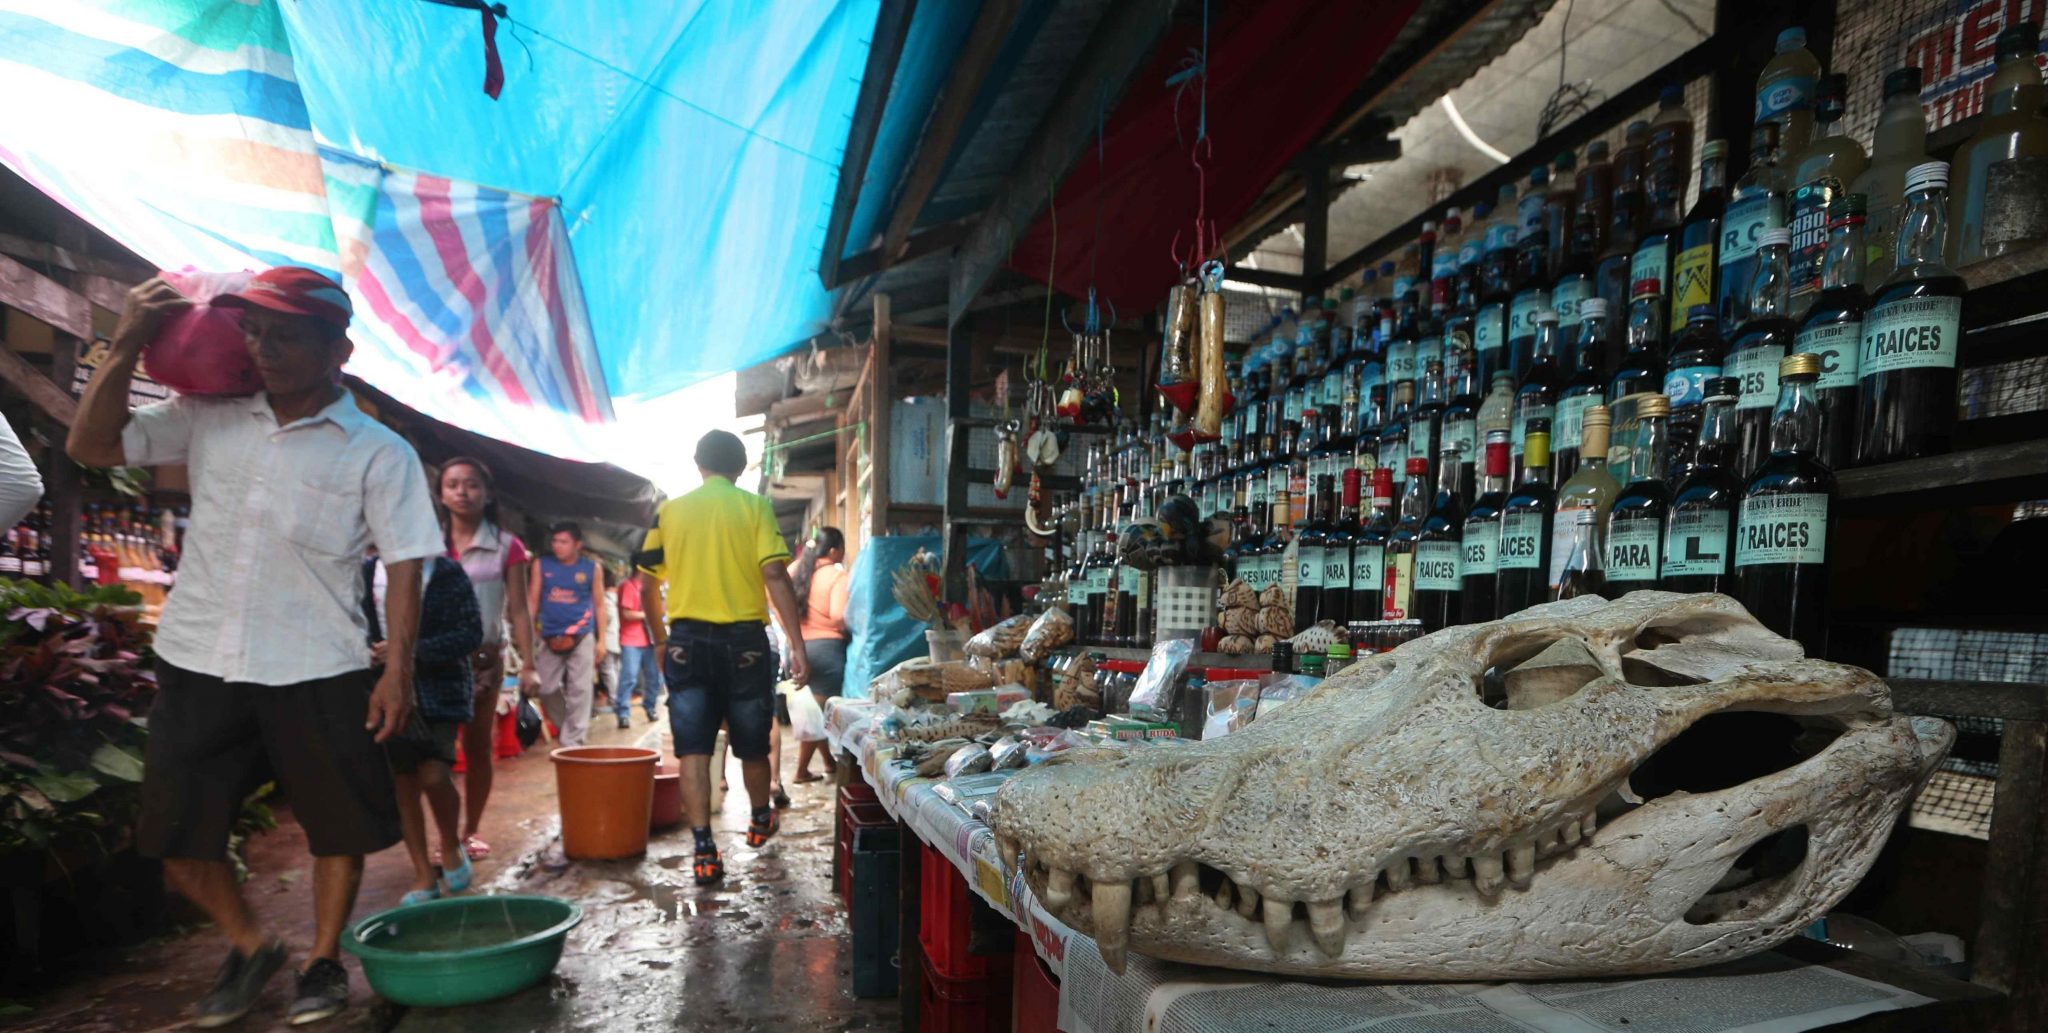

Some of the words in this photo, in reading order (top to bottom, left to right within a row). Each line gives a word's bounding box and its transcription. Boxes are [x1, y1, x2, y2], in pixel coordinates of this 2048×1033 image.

[1725, 229, 1739, 251] R
[1865, 335, 1873, 361] 7
[1875, 324, 1942, 358] RAICES
[1819, 349, 1840, 374] C
[1739, 371, 1765, 396] CES
[1498, 536, 1535, 556] AICES
[1740, 526, 1746, 551] 7
[1748, 521, 1810, 550] RAICES
[1463, 544, 1485, 563] ICES
[1612, 543, 1651, 568] PARA
[1685, 536, 1720, 560] L
[1260, 569, 1283, 583] RAICE
[1326, 563, 1346, 580] PARA
[1420, 560, 1455, 579] RAICES
[1117, 730, 1144, 740] RUDA
[1149, 728, 1176, 739] RUDA
